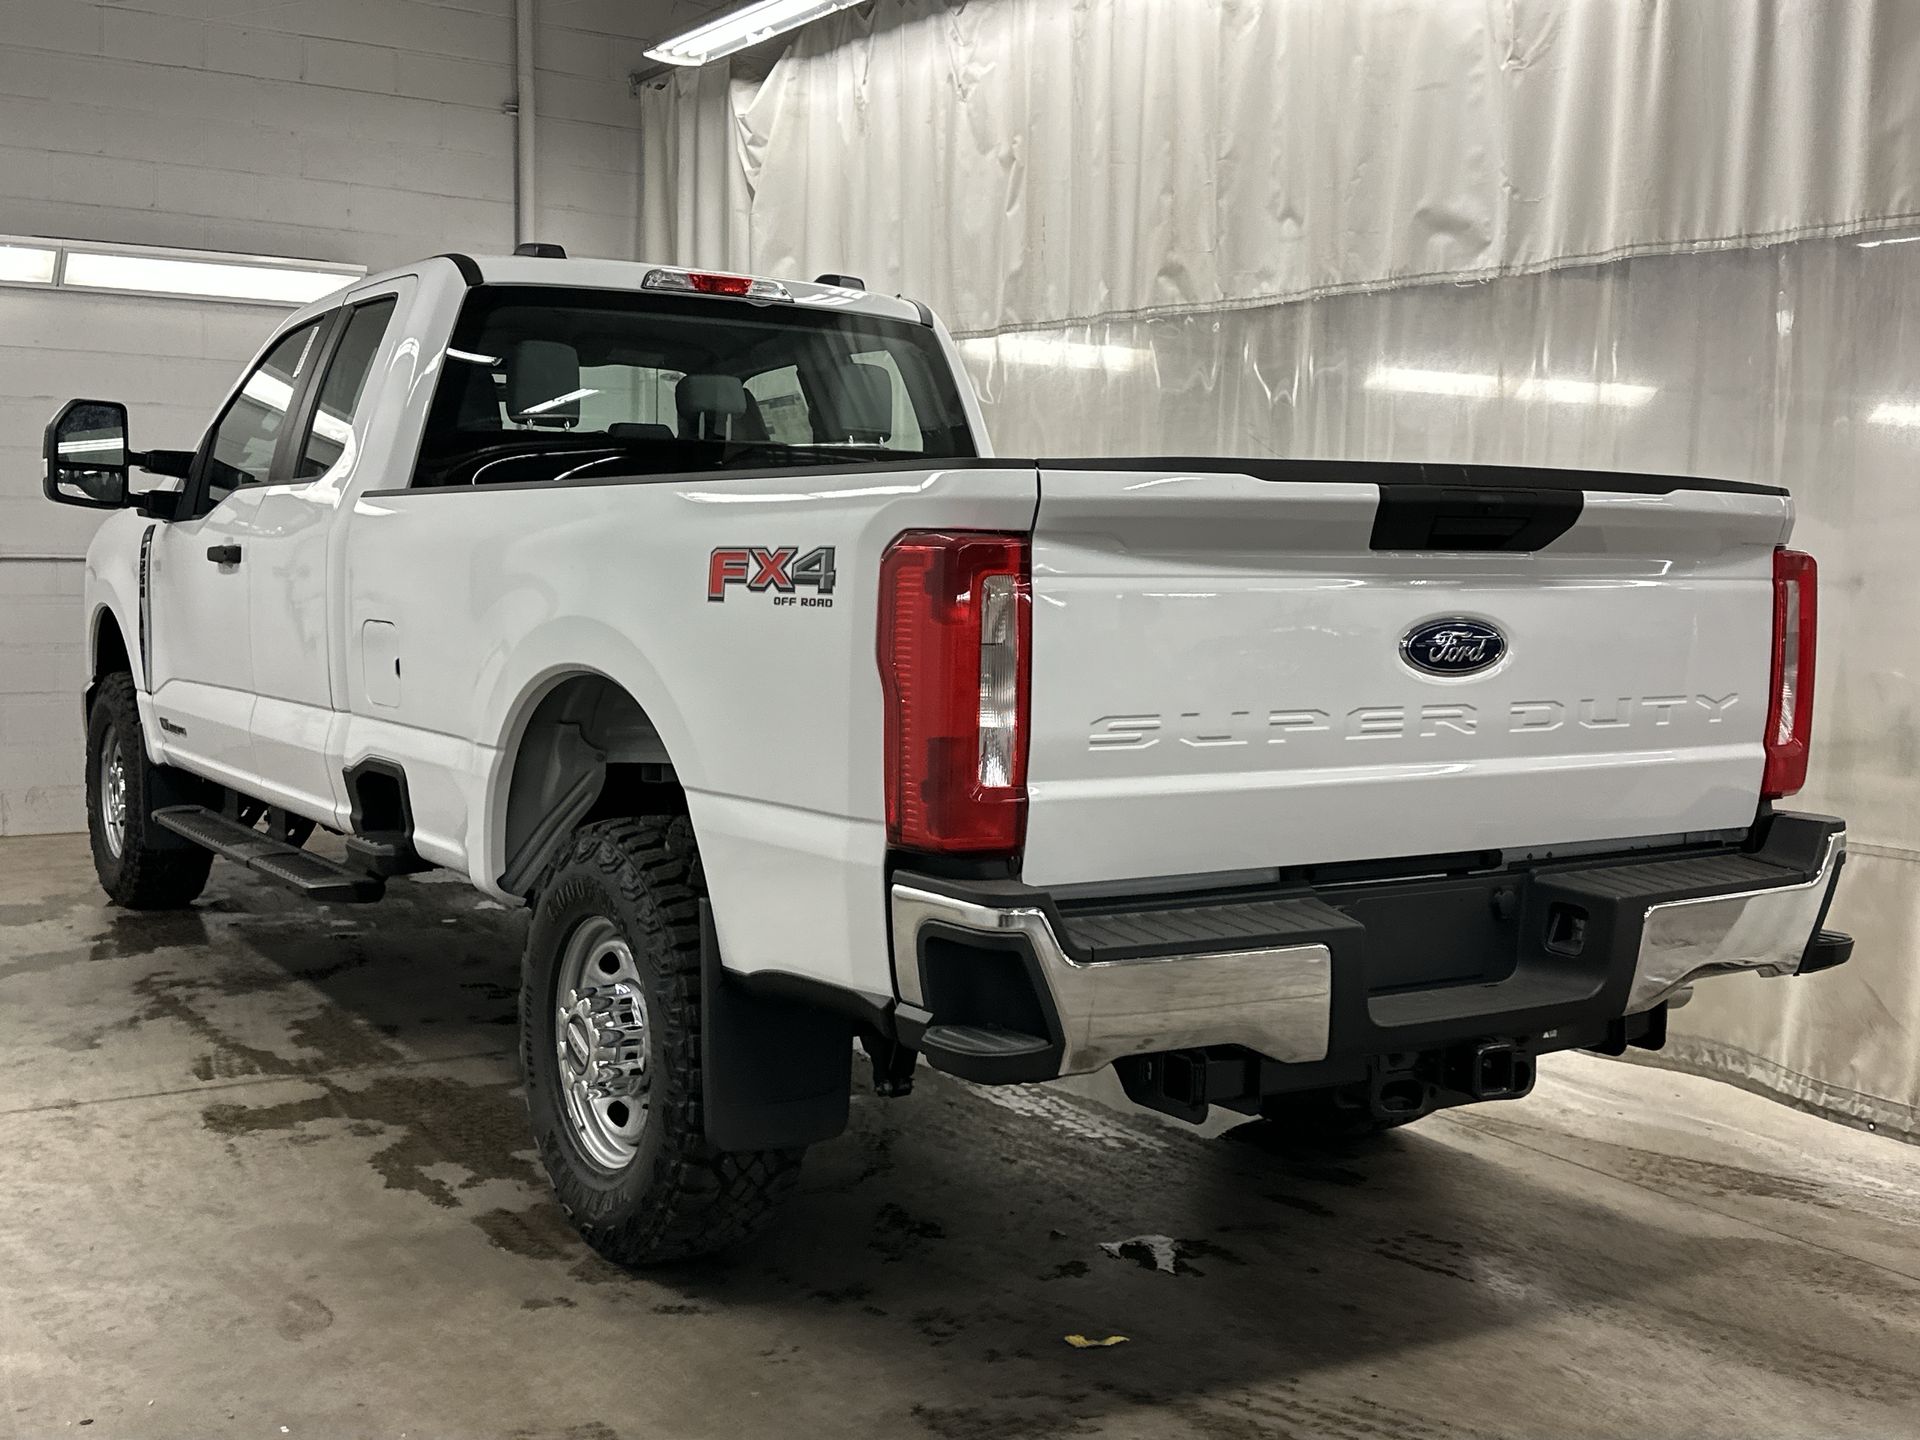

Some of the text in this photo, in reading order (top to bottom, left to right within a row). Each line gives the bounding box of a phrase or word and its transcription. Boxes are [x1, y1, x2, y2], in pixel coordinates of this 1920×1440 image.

[708, 547, 836, 602] FX4
[773, 596, 833, 608] OFF ROAD
[1428, 630, 1488, 662] Ford
[1088, 692, 1739, 751] SUPER DUTY
